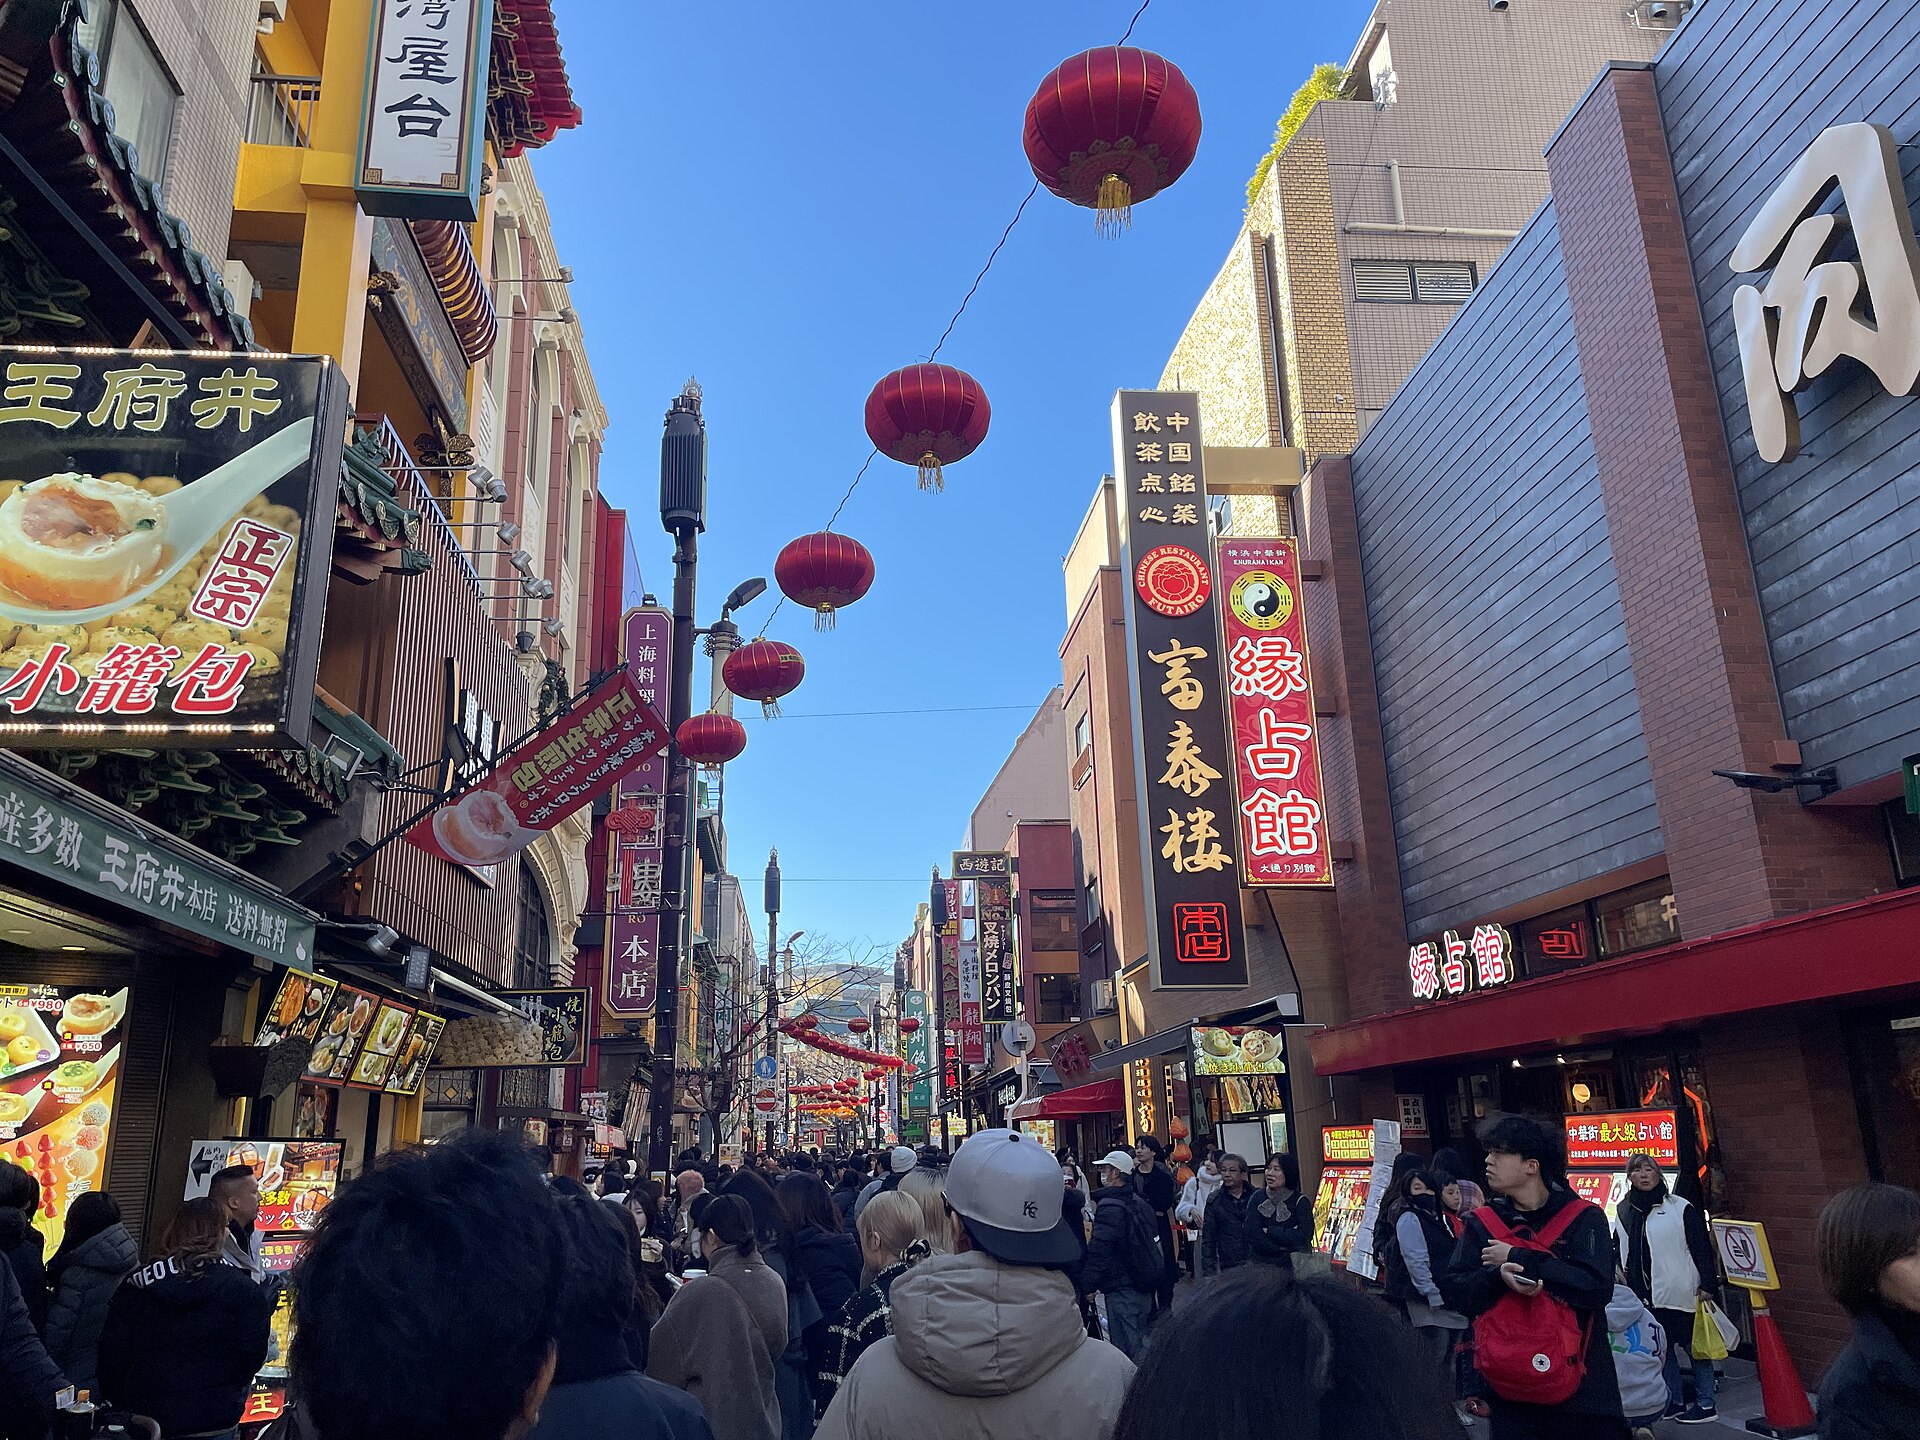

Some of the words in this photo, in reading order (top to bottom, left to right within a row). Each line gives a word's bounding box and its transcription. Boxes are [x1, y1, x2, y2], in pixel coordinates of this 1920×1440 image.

[0, 363, 281, 432] 王府井
[1133, 412, 1168, 524] 飲茶点心
[1166, 412, 1199, 525] 中国銘菜
[199, 527, 281, 621] 正宗
[1138, 550, 1159, 588] CHINESE
[1160, 547, 1210, 586] RESTAURANT
[1227, 549, 1287, 557] 横浜中華街
[1148, 594, 1205, 615] FUTAIRO
[0, 642, 256, 715] 小籠包
[511, 686, 637, 792] 正宗生煎包
[1229, 636, 1321, 856] 縁占館
[527, 729, 656, 824] 本物の焼きショウロンポウ
[958, 857, 1006, 872] 西遊記
[1259, 863, 1316, 874] 大通り別館
[225, 894, 288, 953] 送料無料
[628, 914, 646, 924] RO
[948, 887, 957, 920] オーダー式
[981, 908, 1011, 921] No.1
[1181, 906, 1223, 958] 本店
[618, 934, 650, 999] 本店
[962, 958, 972, 1000] 香港焼き物
[971, 947, 979, 980] 中国料理
[983, 921, 1001, 1010] 叉焼メロンパン
[1408, 923, 1508, 1000] 縁占館
[550, 1006, 566, 1061] 小籠包
[565, 995, 582, 1031] 焼き
[963, 1007, 982, 1046] 龍翔
[1568, 1122, 1673, 1142] 中華街最大級占い館
